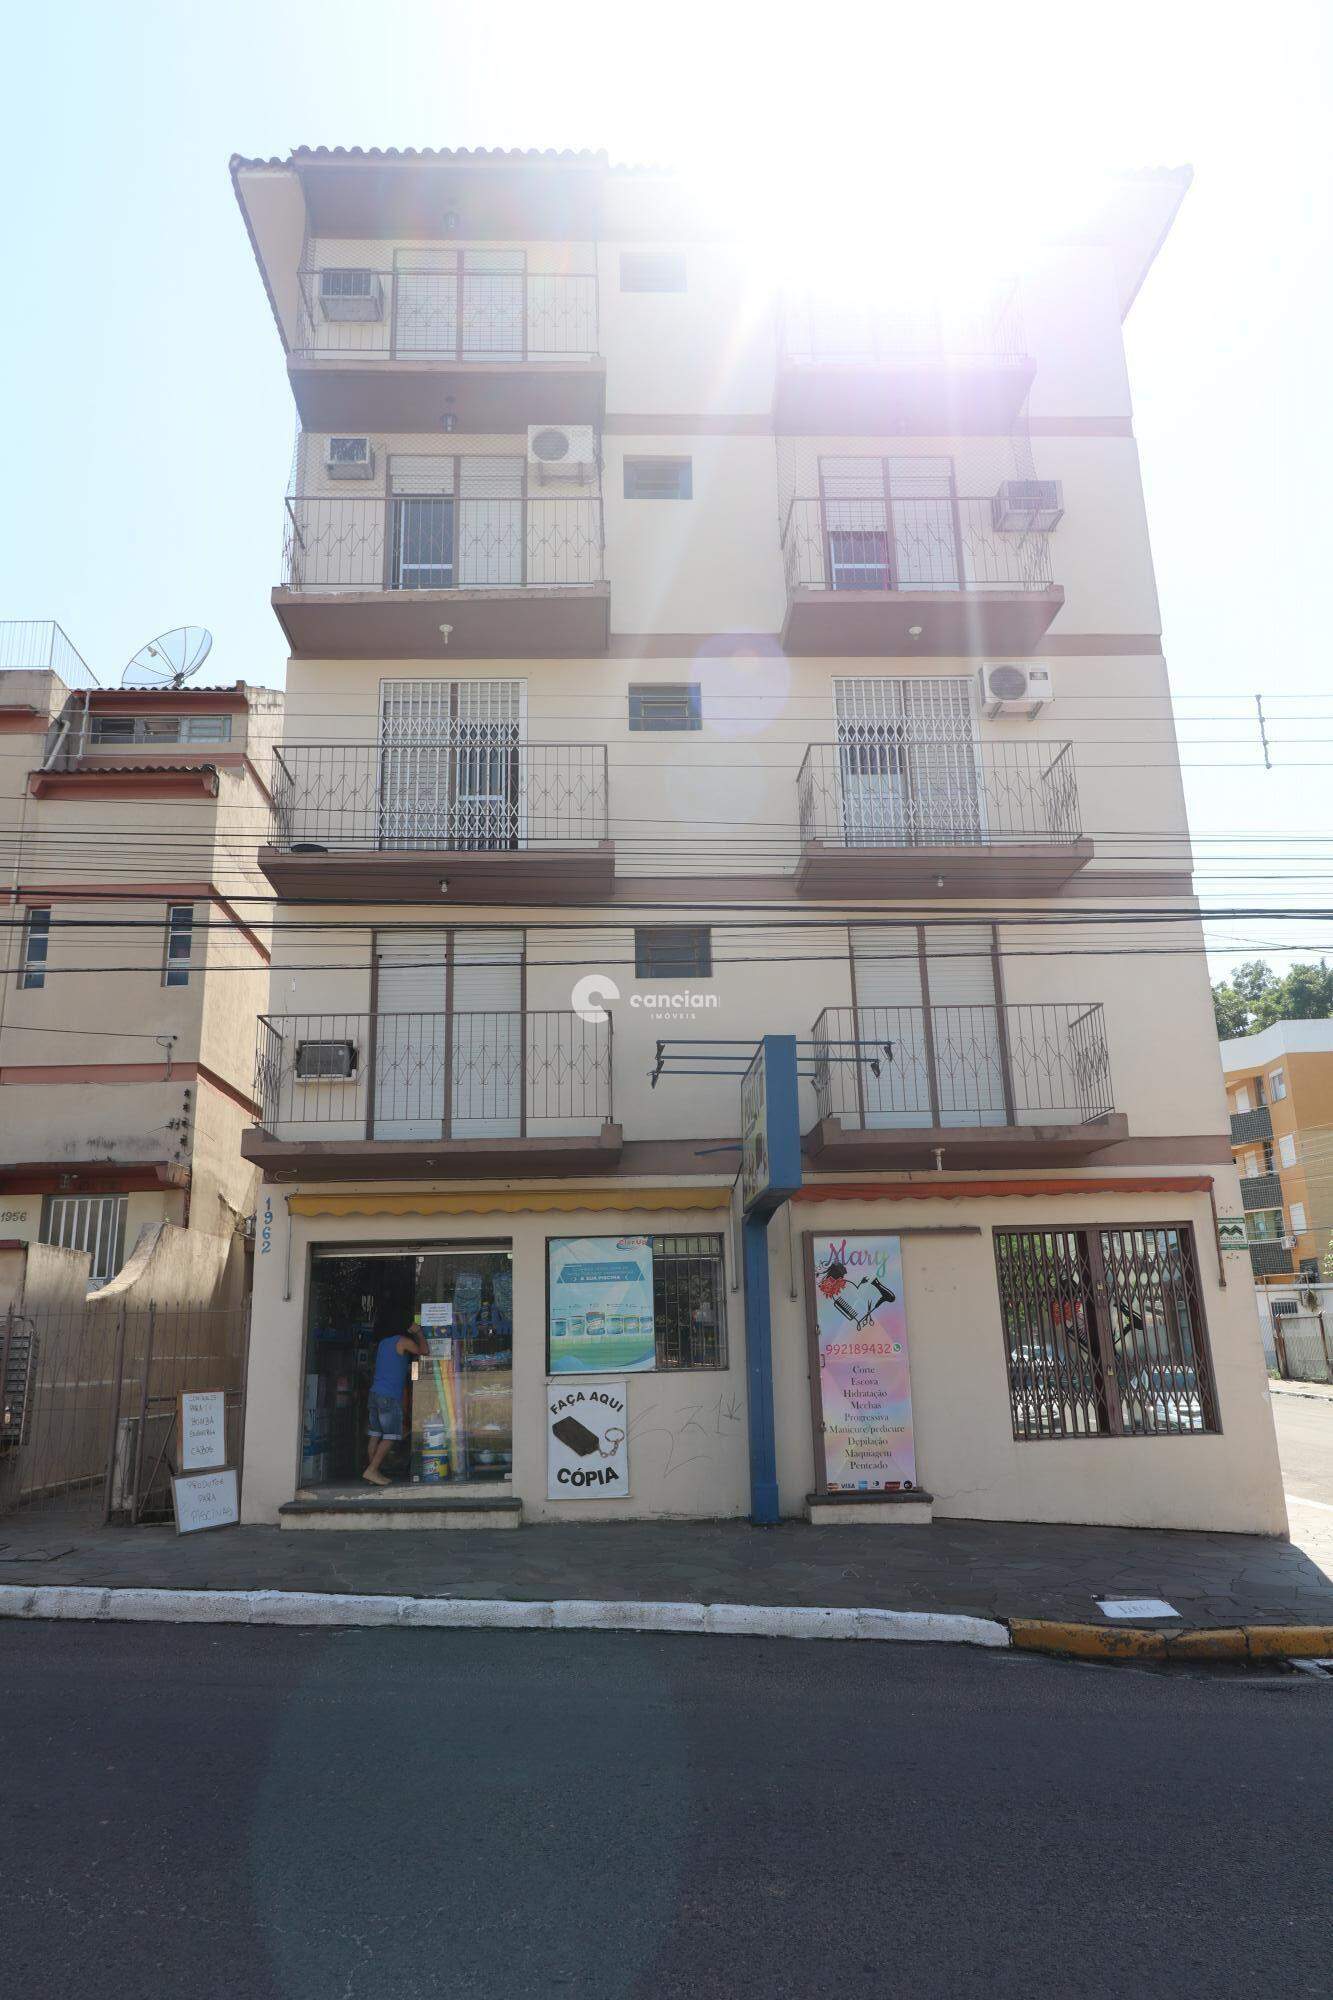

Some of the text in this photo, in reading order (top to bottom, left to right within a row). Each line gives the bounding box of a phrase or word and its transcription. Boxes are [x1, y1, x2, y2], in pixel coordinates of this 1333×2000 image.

[0, 1211, 27, 1222] 1956
[261, 1197, 273, 1255] 1962
[823, 1239, 890, 1278] Mary
[825, 1343, 892, 1355] 992189432
[852, 1365, 876, 1374] Corte
[851, 1377, 879, 1386] Escova
[843, 1389, 888, 1398] Hidratação
[550, 1391, 624, 1415] FAÇA AQUI
[851, 1401, 881, 1410] Mechas
[844, 1413, 889, 1422] Progressiva
[848, 1437, 888, 1446] Depilação
[845, 1449, 892, 1458] Maquiagem
[850, 1461, 888, 1470] Penteado
[557, 1466, 619, 1487] CÓPIA
